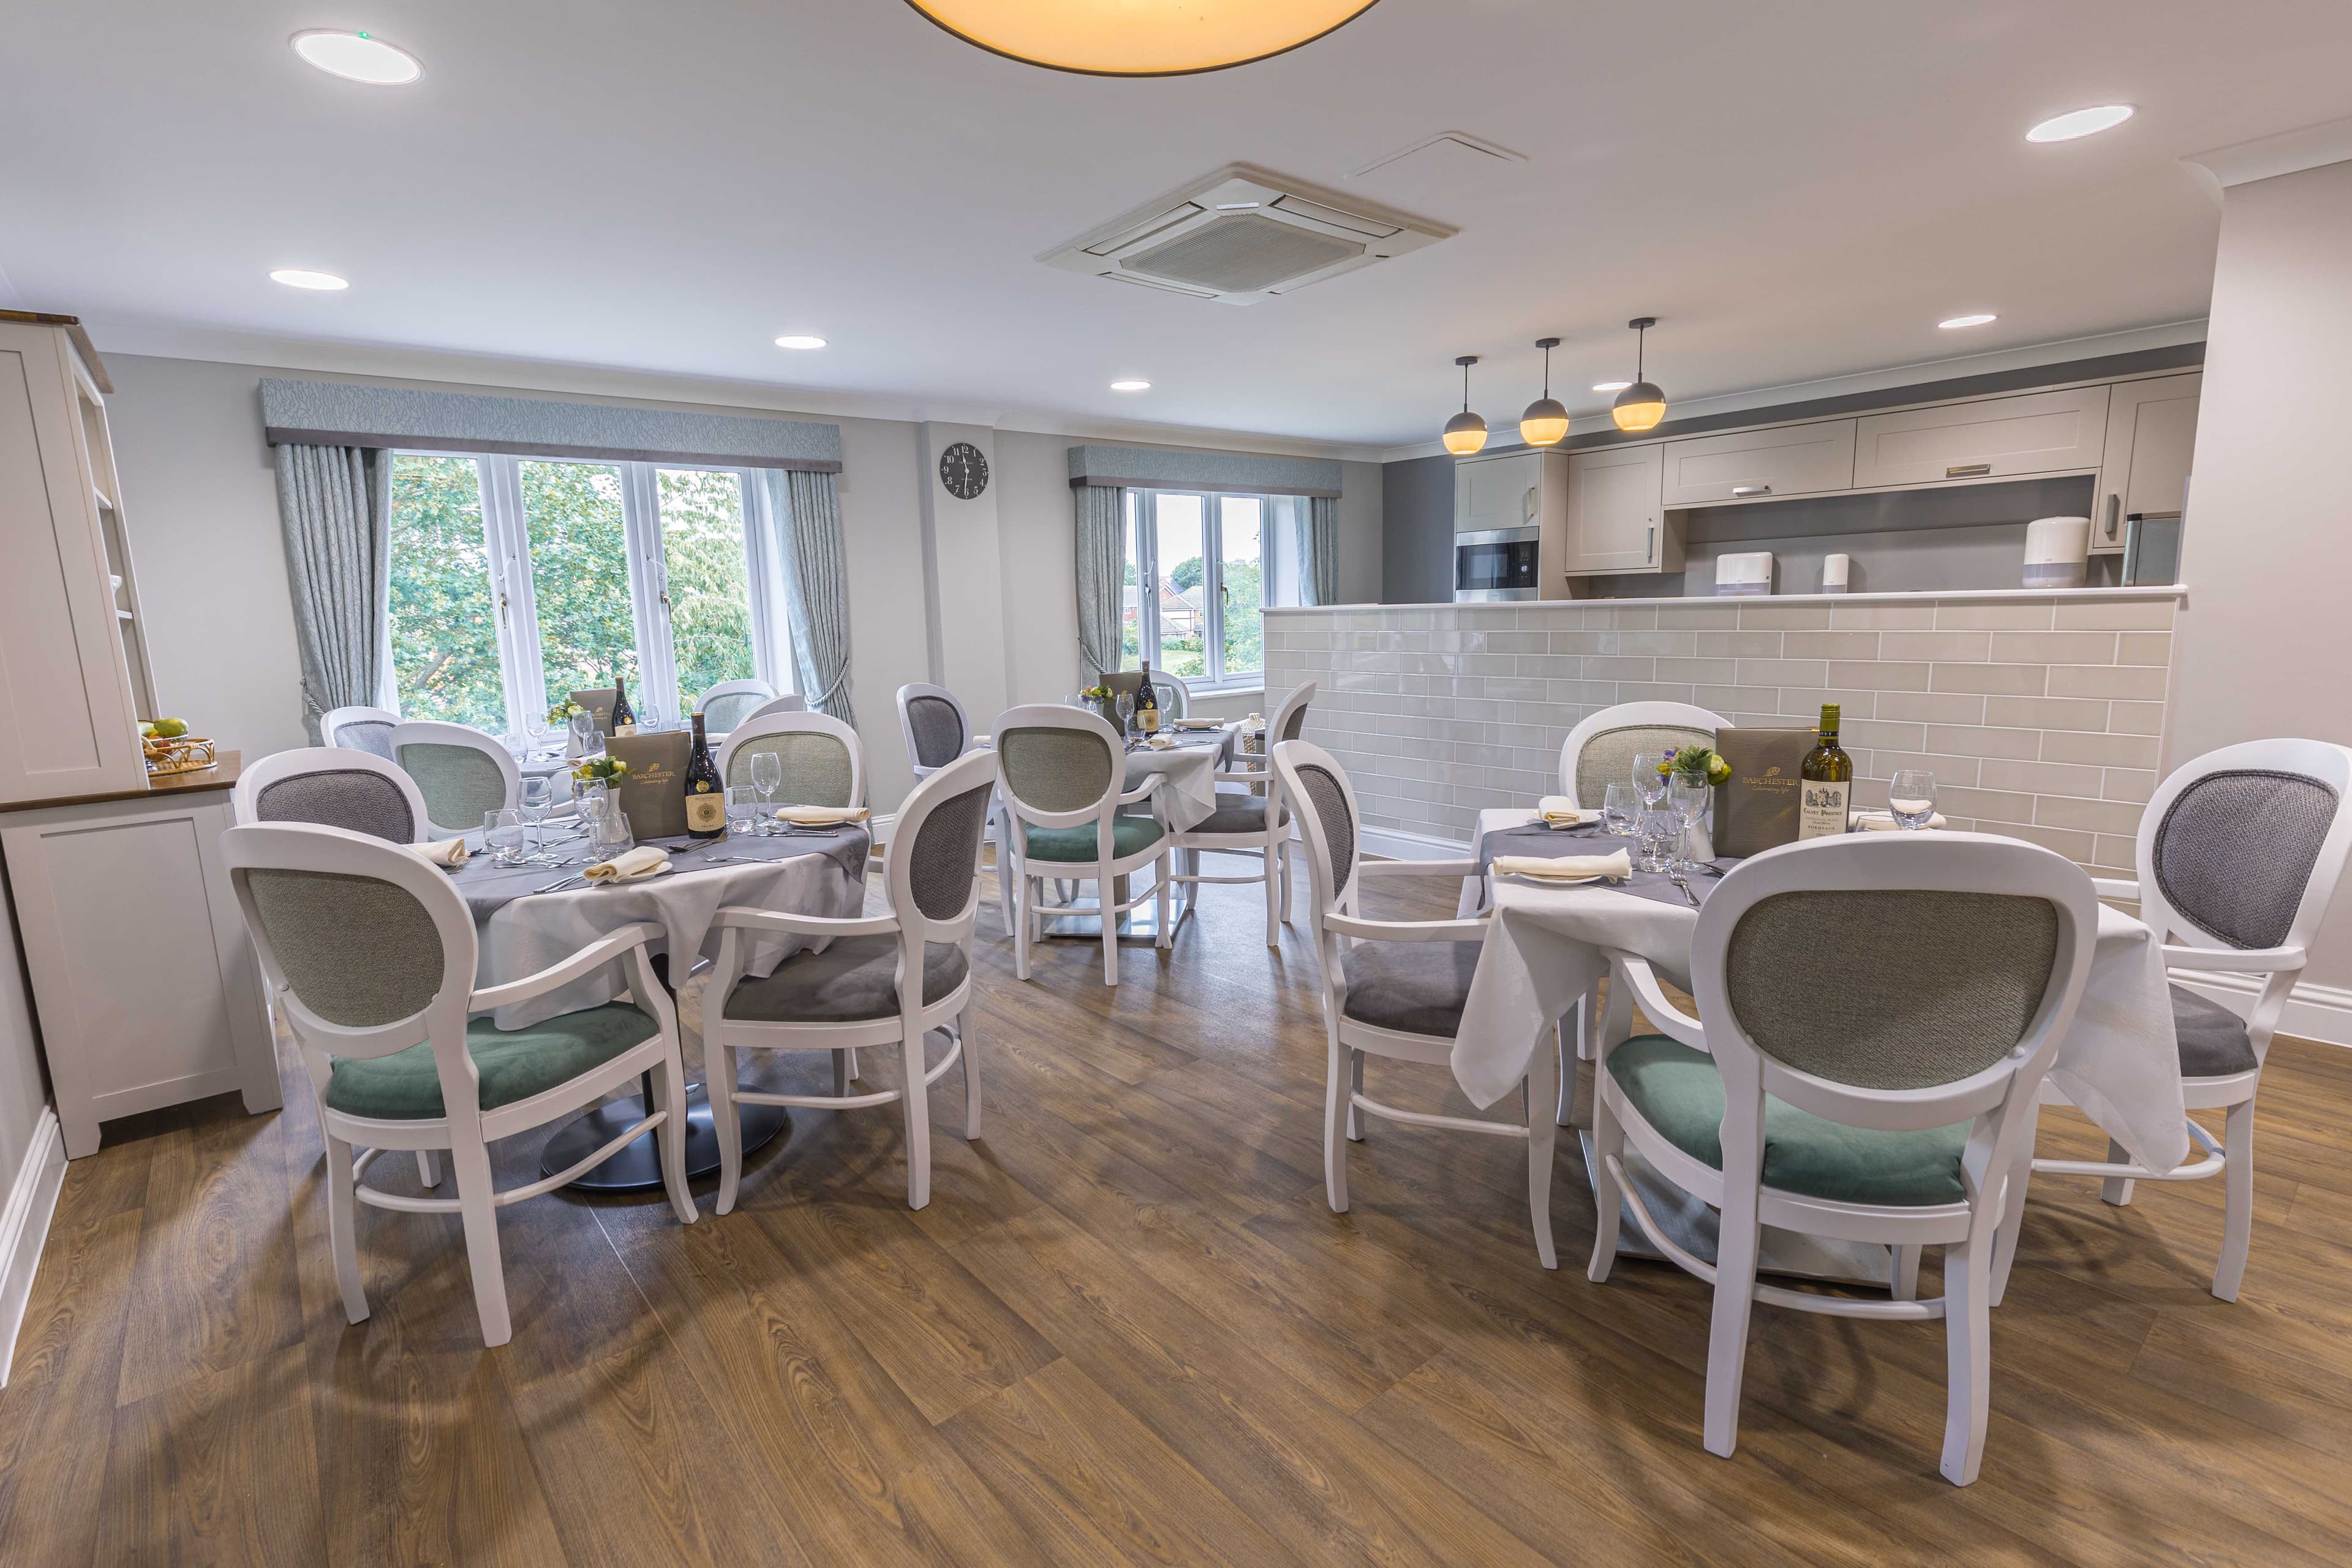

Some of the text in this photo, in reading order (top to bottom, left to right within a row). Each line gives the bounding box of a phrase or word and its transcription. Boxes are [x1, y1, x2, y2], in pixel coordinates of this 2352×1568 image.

[979, 458, 984, 466] 2
[943, 466, 949, 474] 9
[982, 468, 987, 477] 3
[979, 478, 984, 487] 4
[973, 486, 978, 494] 5
[632, 771, 676, 780] BARCHESTER
[1743, 777, 1800, 786] BARCHESTER
